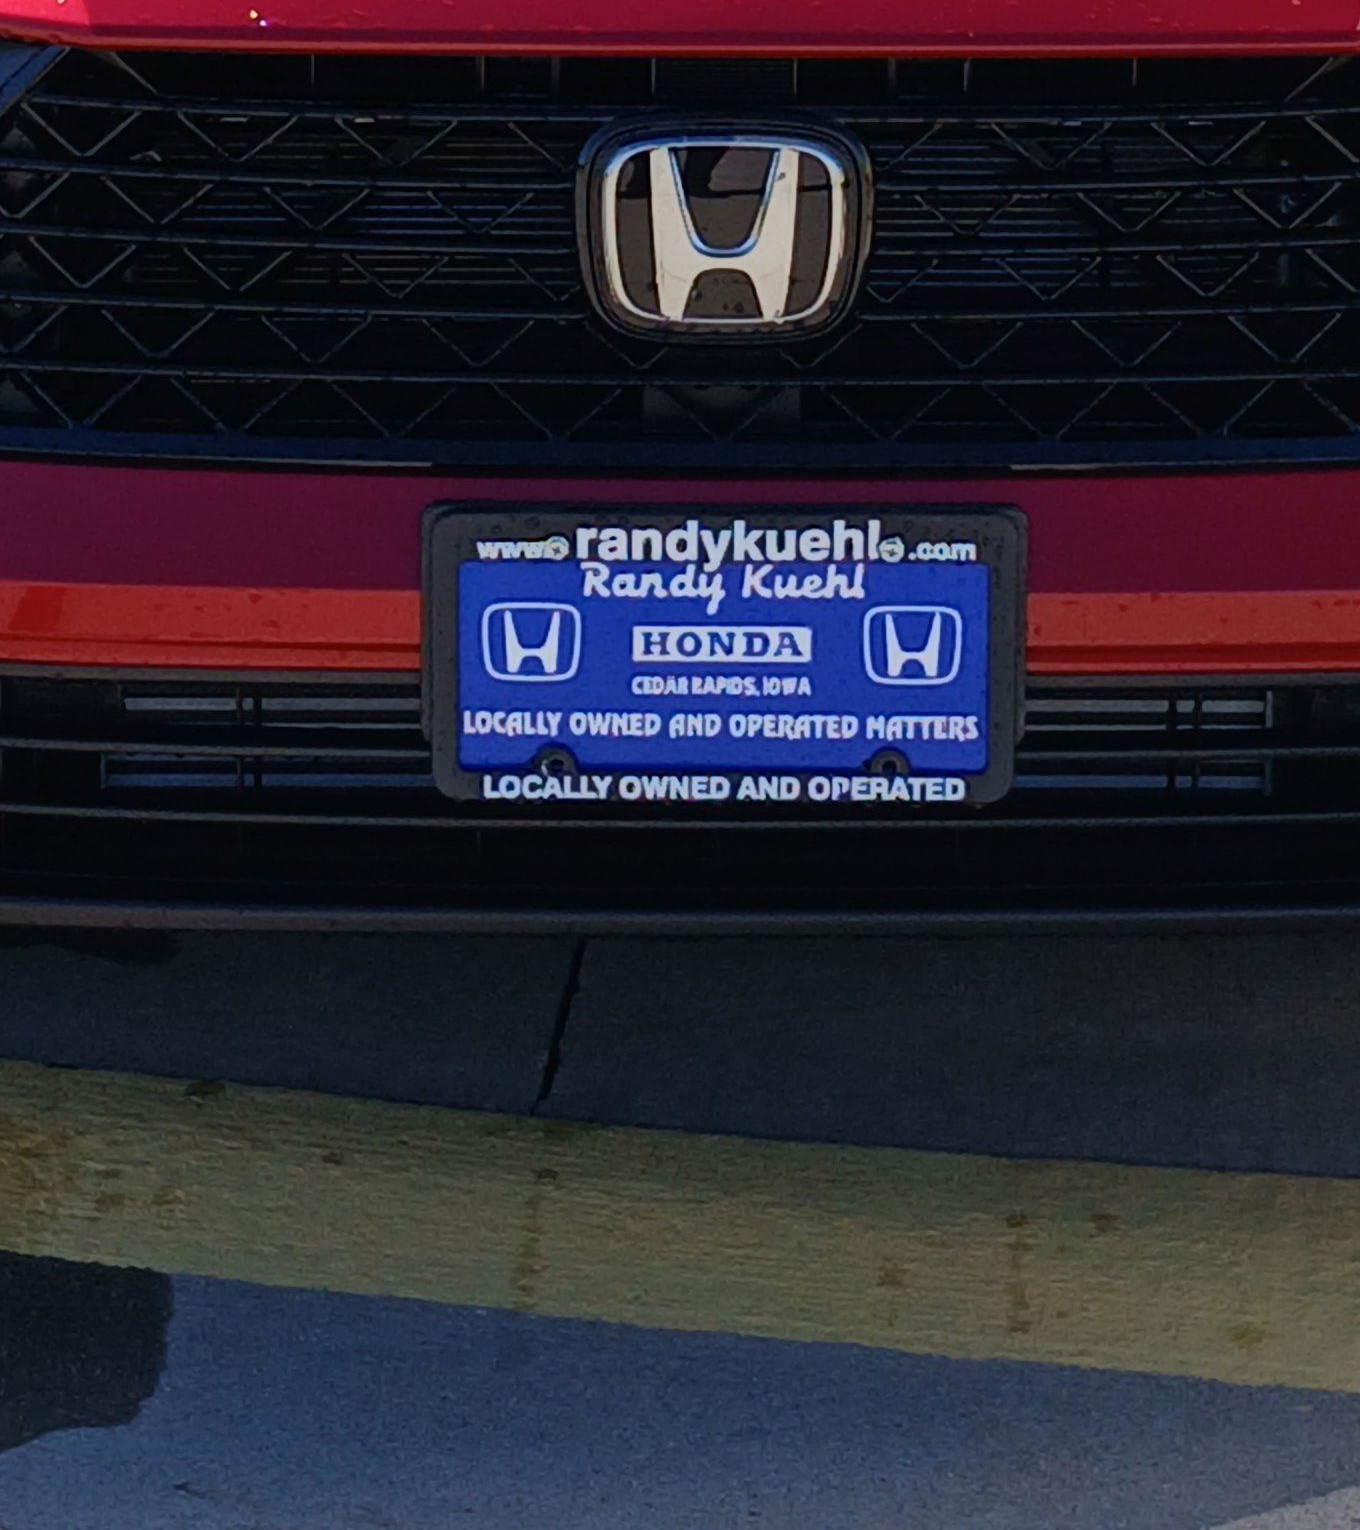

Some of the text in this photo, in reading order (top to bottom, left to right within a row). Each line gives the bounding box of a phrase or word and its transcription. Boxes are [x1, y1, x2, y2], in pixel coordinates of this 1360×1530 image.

[580, 561, 866, 616] Randy Kuehl
[641, 631, 804, 658] HONDA
[762, 675, 812, 697] IOWA
[463, 710, 979, 742] LOCALLY OWNED AND OPERATED MATTERS
[483, 774, 966, 802] LOCALLY OWNED AND OPERATED
